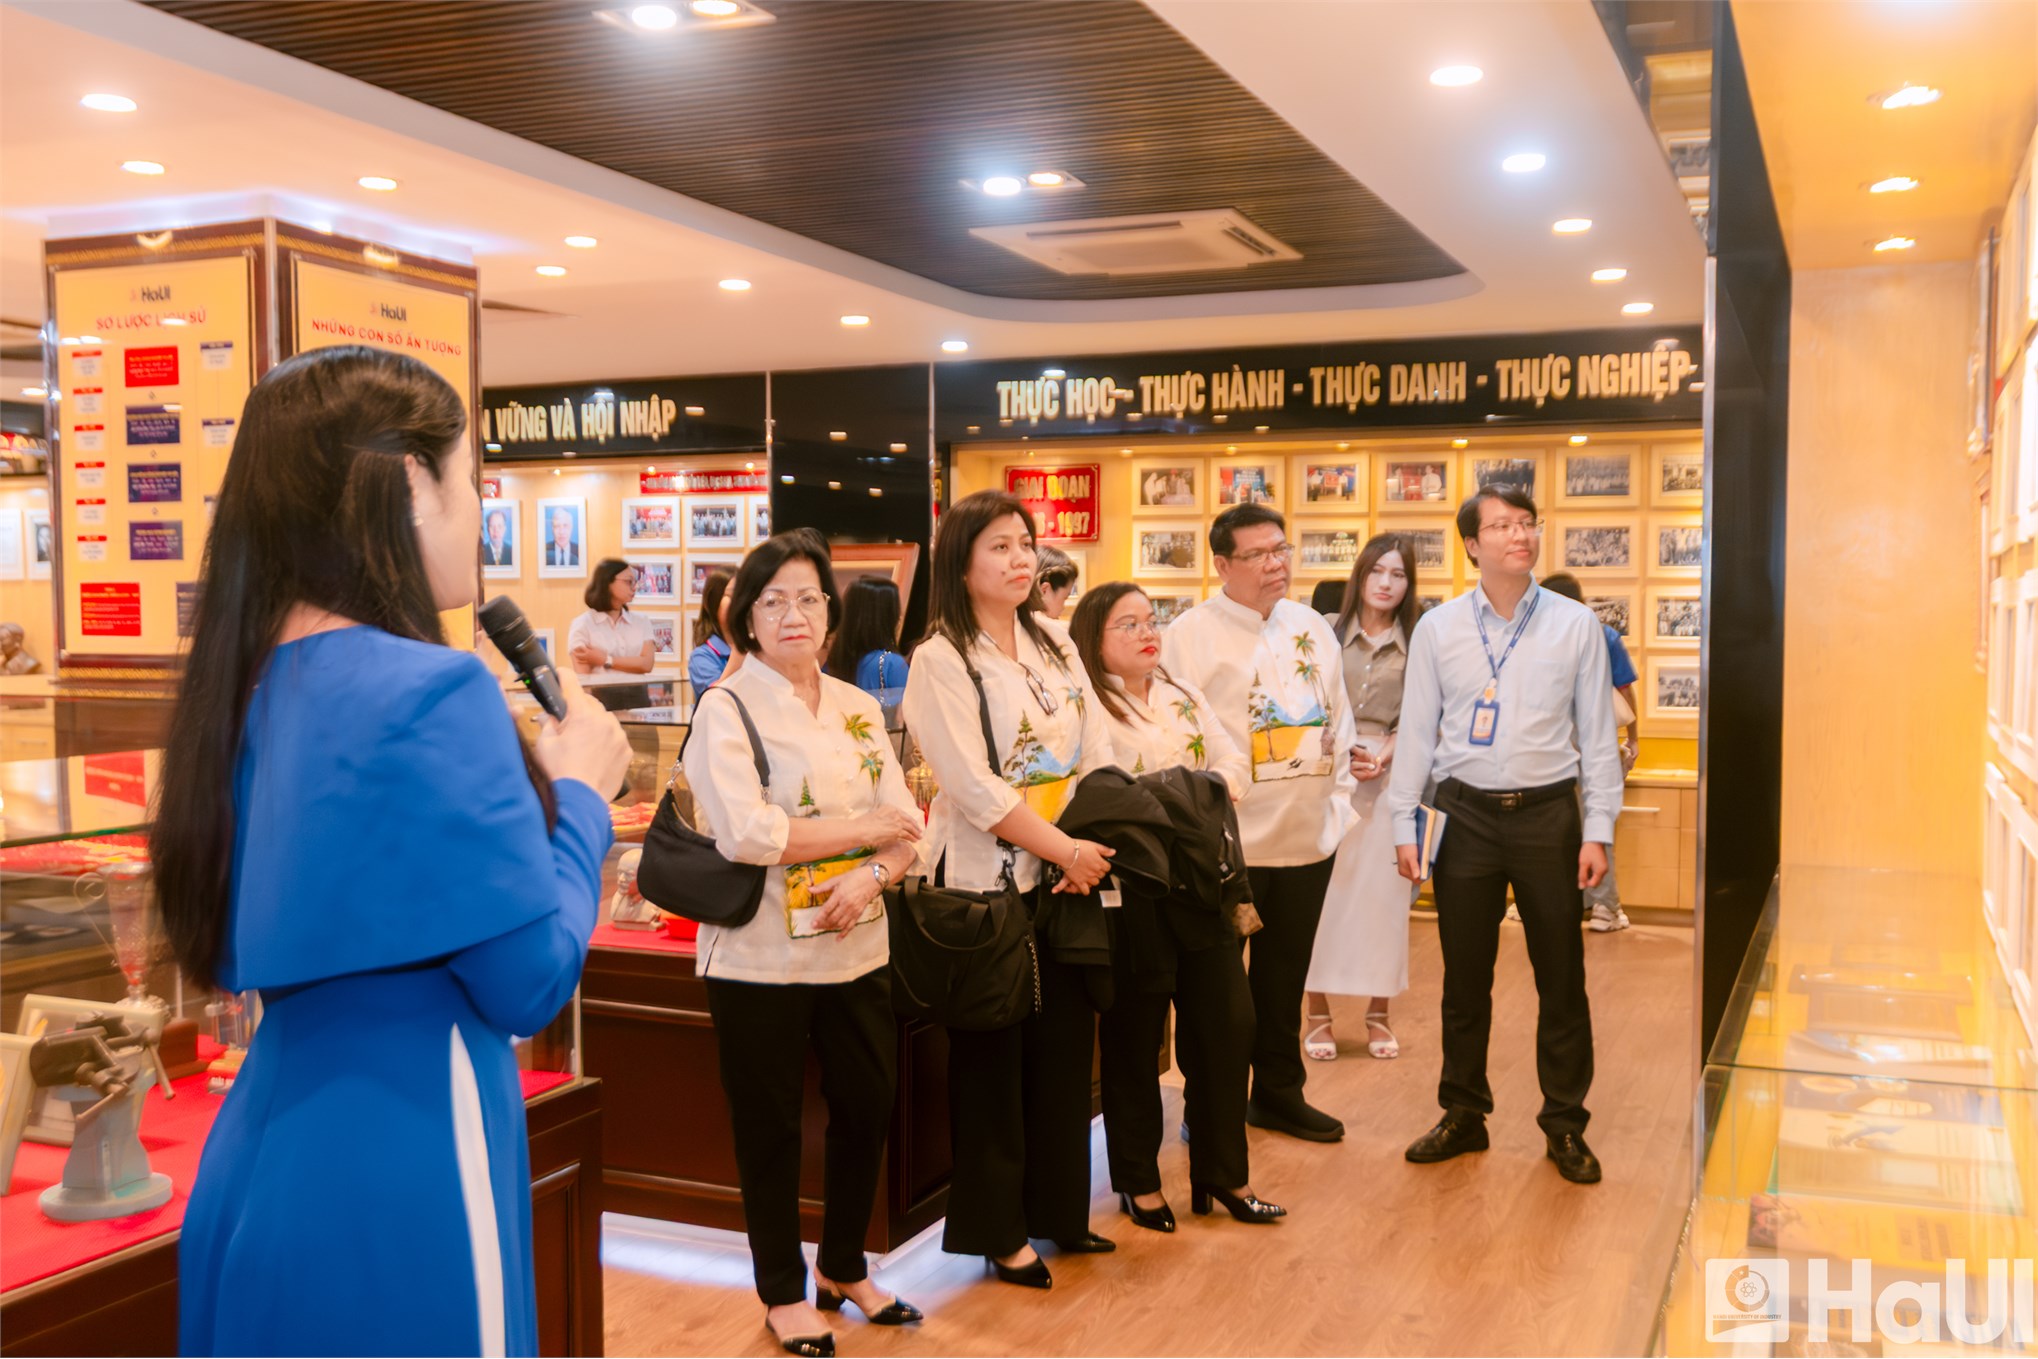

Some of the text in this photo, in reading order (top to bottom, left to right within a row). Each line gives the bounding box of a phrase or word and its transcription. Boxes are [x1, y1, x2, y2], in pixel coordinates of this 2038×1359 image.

[381, 303, 406, 321] HaUI
[359, 327, 384, 342] CON
[996, 376, 1060, 426] THỰC
[1066, 377, 1116, 424] HỌC
[1140, 370, 1205, 419] THỰC
[1211, 363, 1285, 411] HÀNH
[1310, 361, 1381, 413] THỰC
[1389, 361, 1467, 405] DANH
[1496, 353, 1571, 408] THỰC
[1577, 346, 1691, 402] NGHIỆP
[495, 401, 548, 443] VỮNG
[550, 398, 577, 441] VÀ
[581, 399, 615, 444] HỘI
[619, 393, 677, 442] NHẬP
